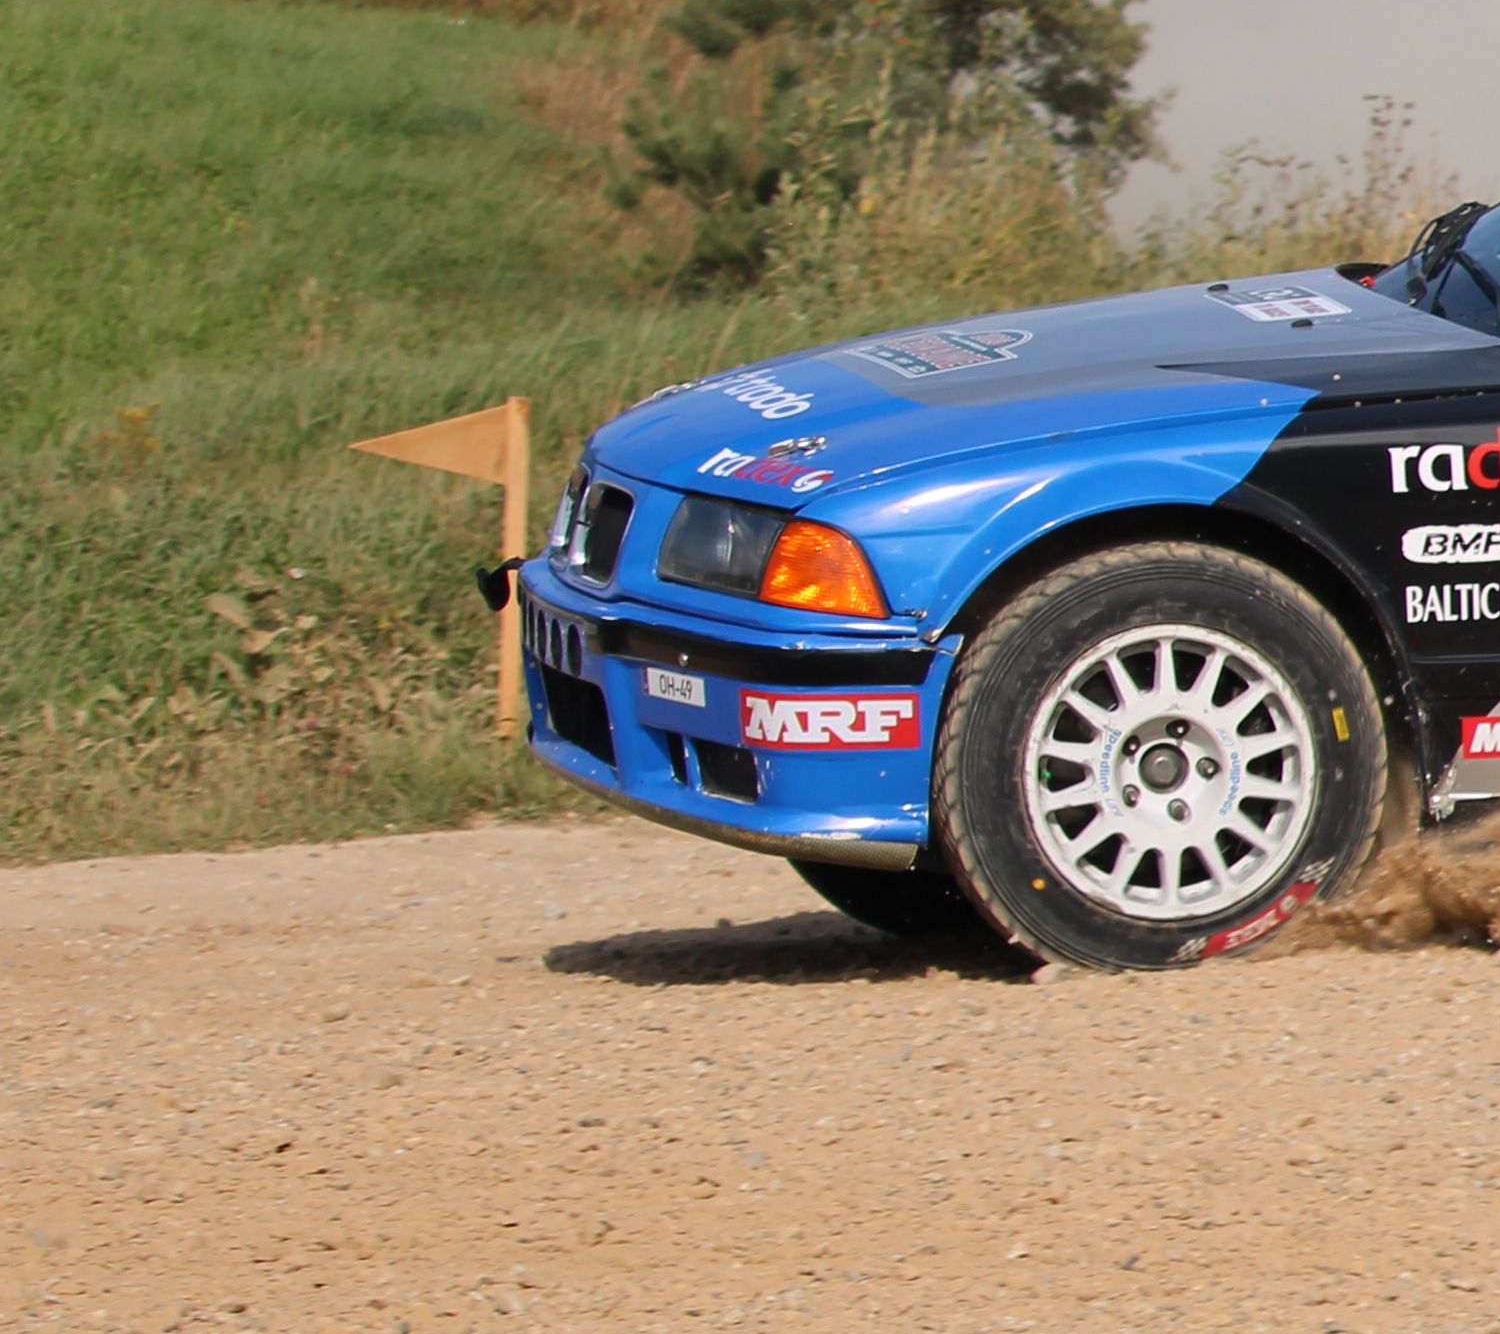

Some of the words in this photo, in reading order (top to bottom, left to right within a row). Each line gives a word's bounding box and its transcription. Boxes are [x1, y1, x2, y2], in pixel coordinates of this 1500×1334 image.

[1405, 582, 1500, 623] BALTIC
[659, 674, 693, 700] OH-49
[745, 697, 913, 743] MRF
